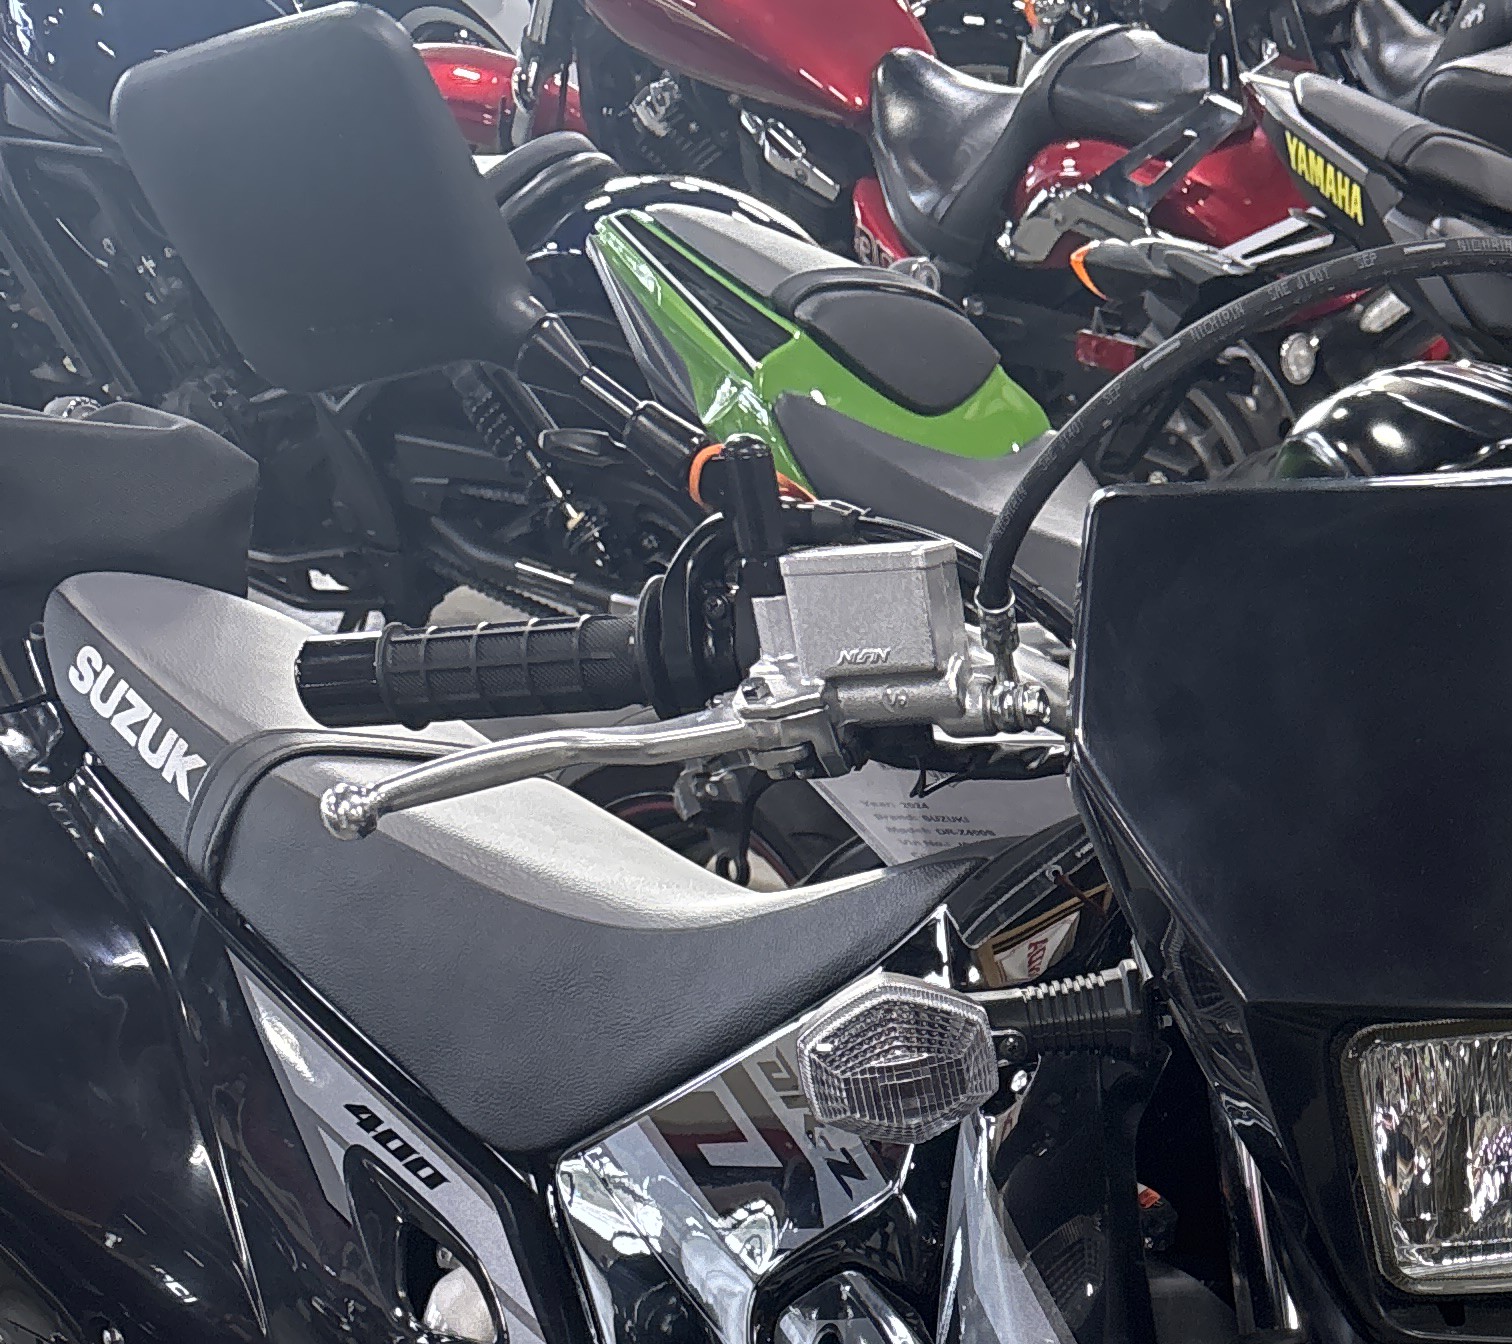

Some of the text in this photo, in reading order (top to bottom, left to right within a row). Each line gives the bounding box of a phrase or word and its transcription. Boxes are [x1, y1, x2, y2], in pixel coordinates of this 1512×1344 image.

[1285, 130, 1364, 226] YAMAHA
[69, 645, 207, 802] SUZUK
[921, 814, 970, 824] SUZUKI
[343, 1103, 451, 1190] 400
